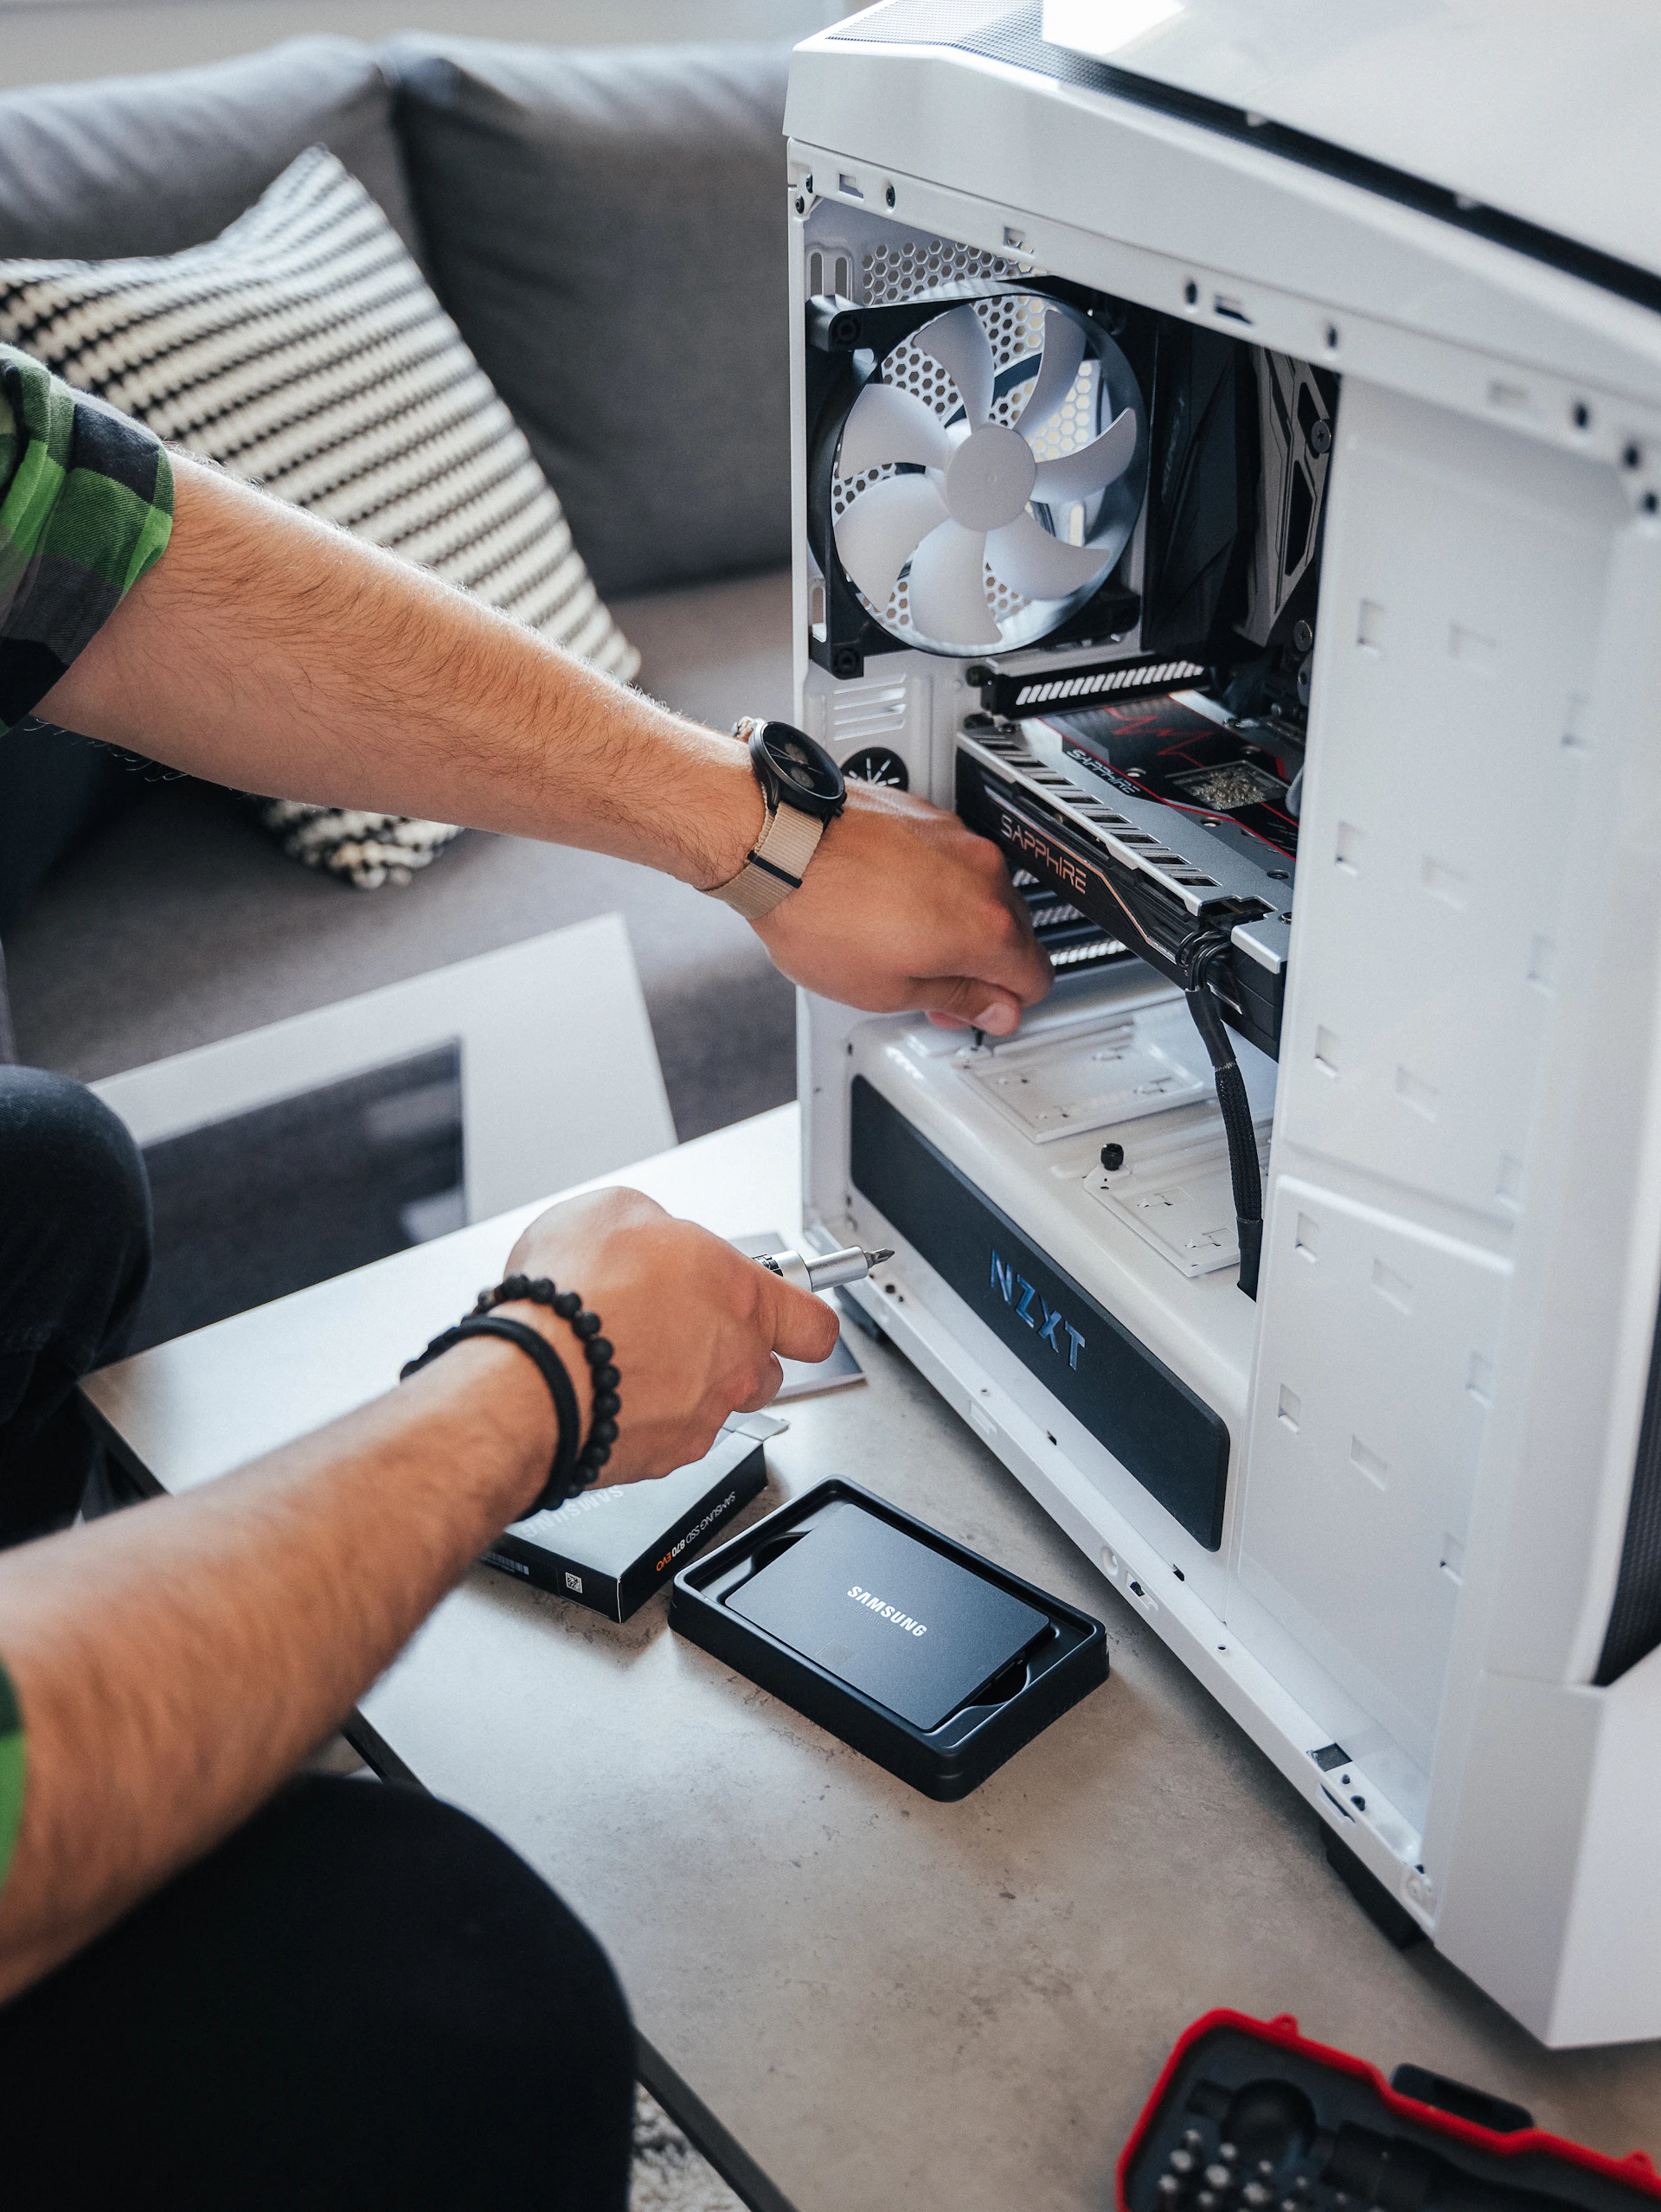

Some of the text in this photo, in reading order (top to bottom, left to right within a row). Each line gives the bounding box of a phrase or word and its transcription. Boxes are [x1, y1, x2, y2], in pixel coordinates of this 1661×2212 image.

[1066, 748, 1141, 795] SAPPHIRE
[1000, 813, 1087, 895] SAPPHIRE
[990, 1248, 1086, 1371] NZXT
[520, 1485, 625, 1538] SAMSUNG
[656, 1491, 736, 1572] SAMSUNG SSD 870 EVO
[847, 1586, 927, 1637] SAMSUNG
